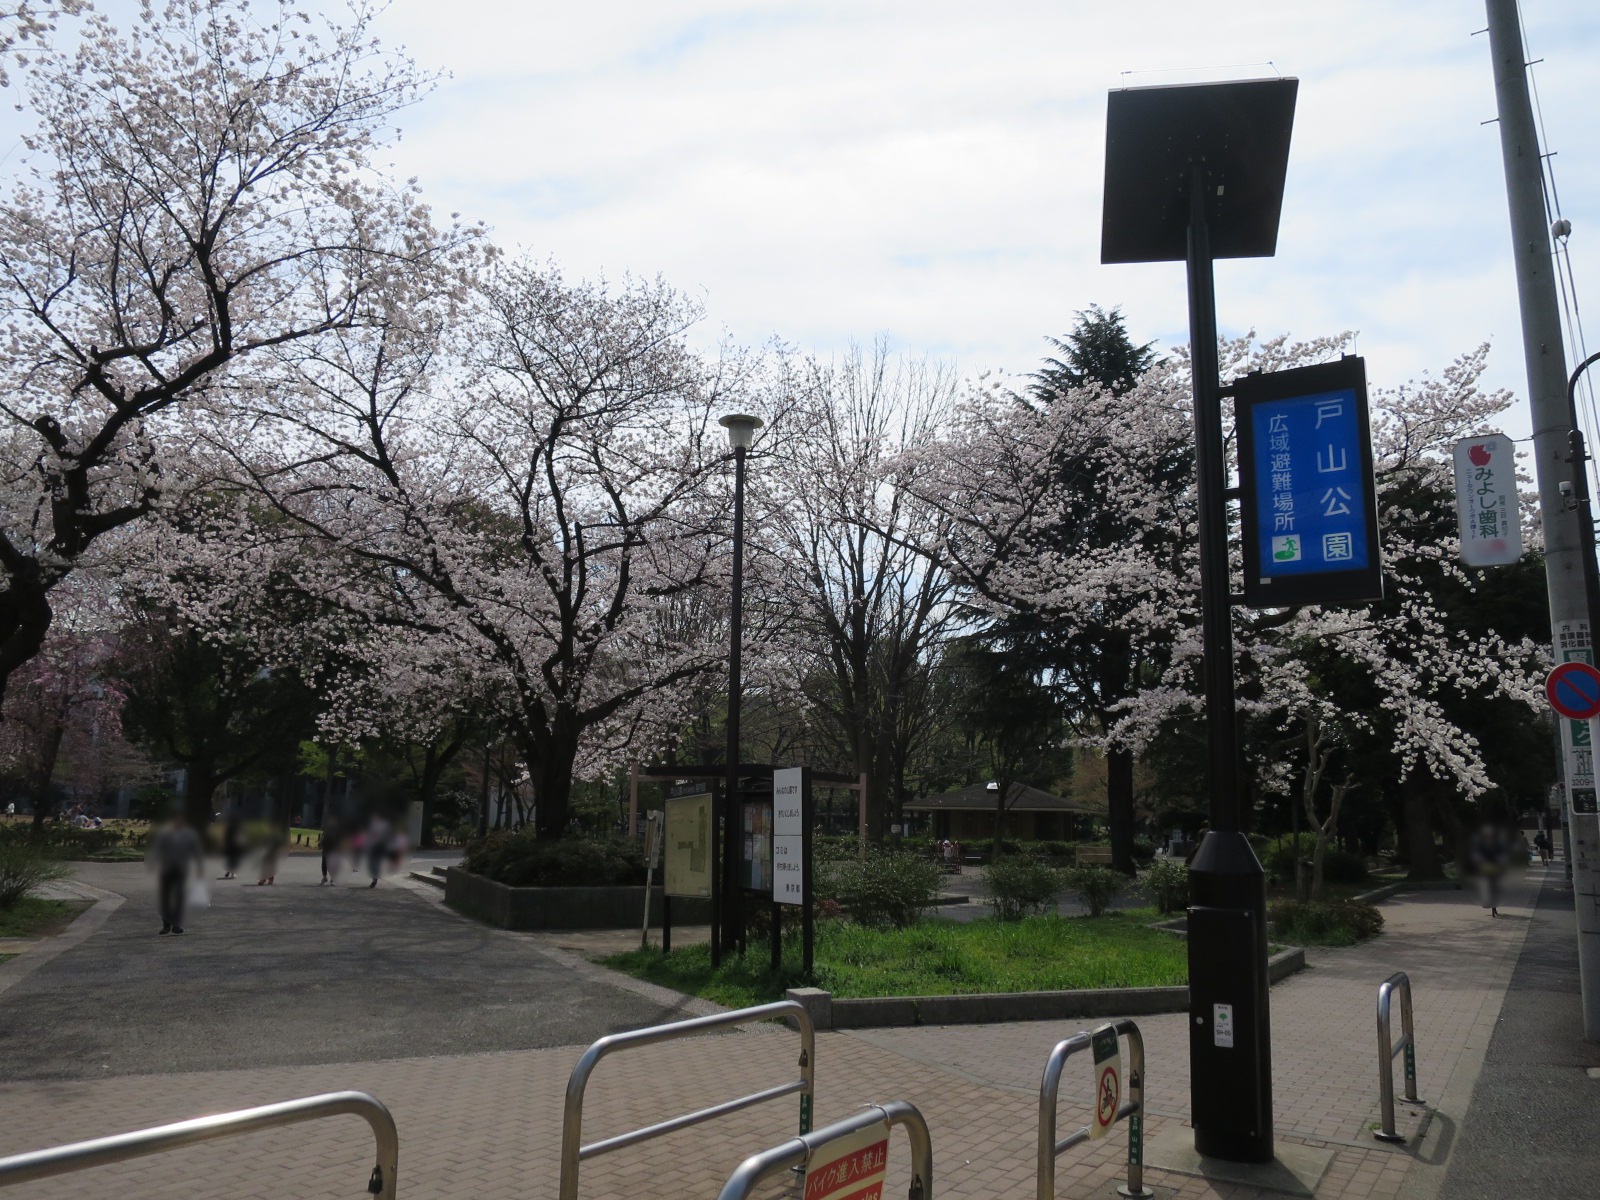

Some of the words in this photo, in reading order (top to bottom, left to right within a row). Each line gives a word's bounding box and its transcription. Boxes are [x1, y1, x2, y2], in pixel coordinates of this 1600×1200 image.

[1268, 413, 1296, 532] 広域避難場所
[1314, 398, 1353, 562] 戸山公園
[1475, 467, 1499, 539] みよし歯科
[807, 1147, 885, 1198] バイク進入禁止
